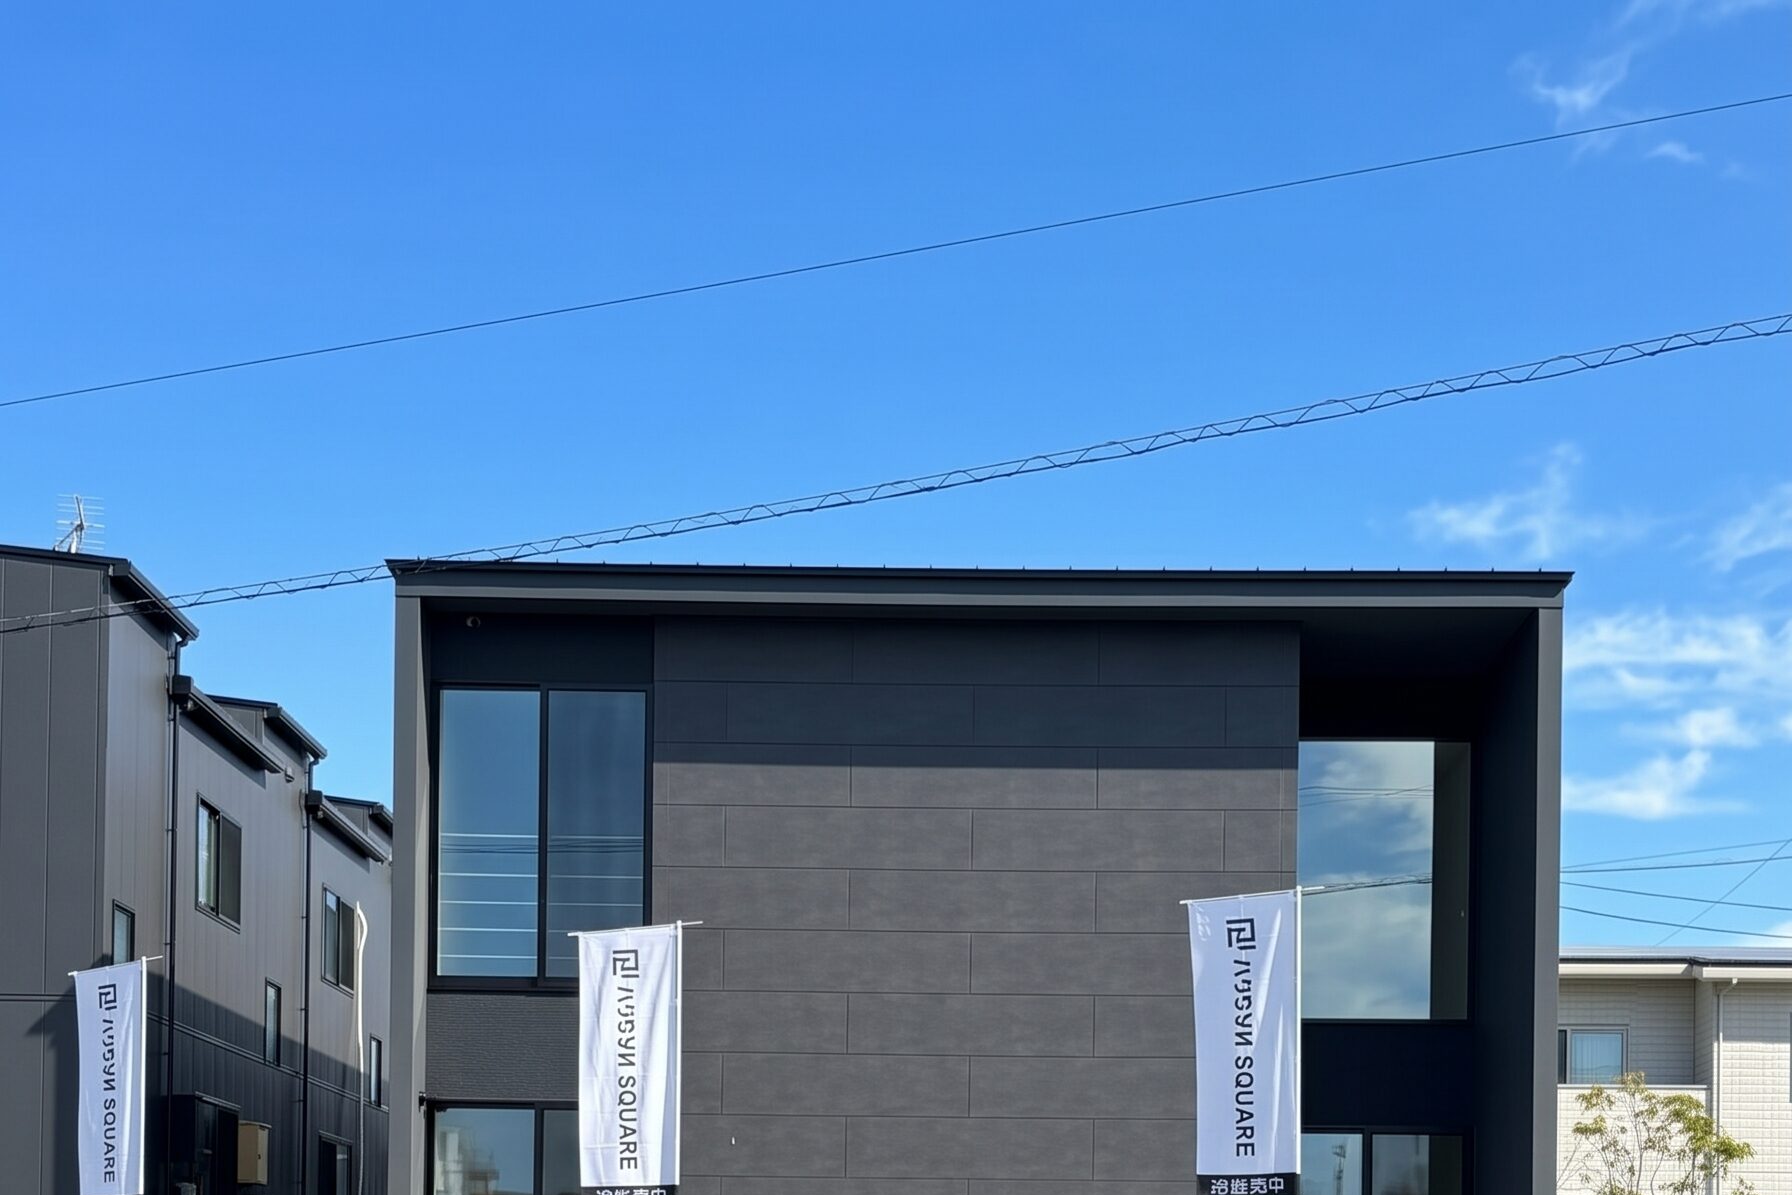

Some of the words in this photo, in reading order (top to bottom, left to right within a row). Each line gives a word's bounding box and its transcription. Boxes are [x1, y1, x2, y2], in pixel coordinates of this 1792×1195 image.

[103, 1097, 116, 1184] SQUARE
[618, 1075, 638, 1171] SQUARE
[1234, 1055, 1255, 1157] SQUARE
